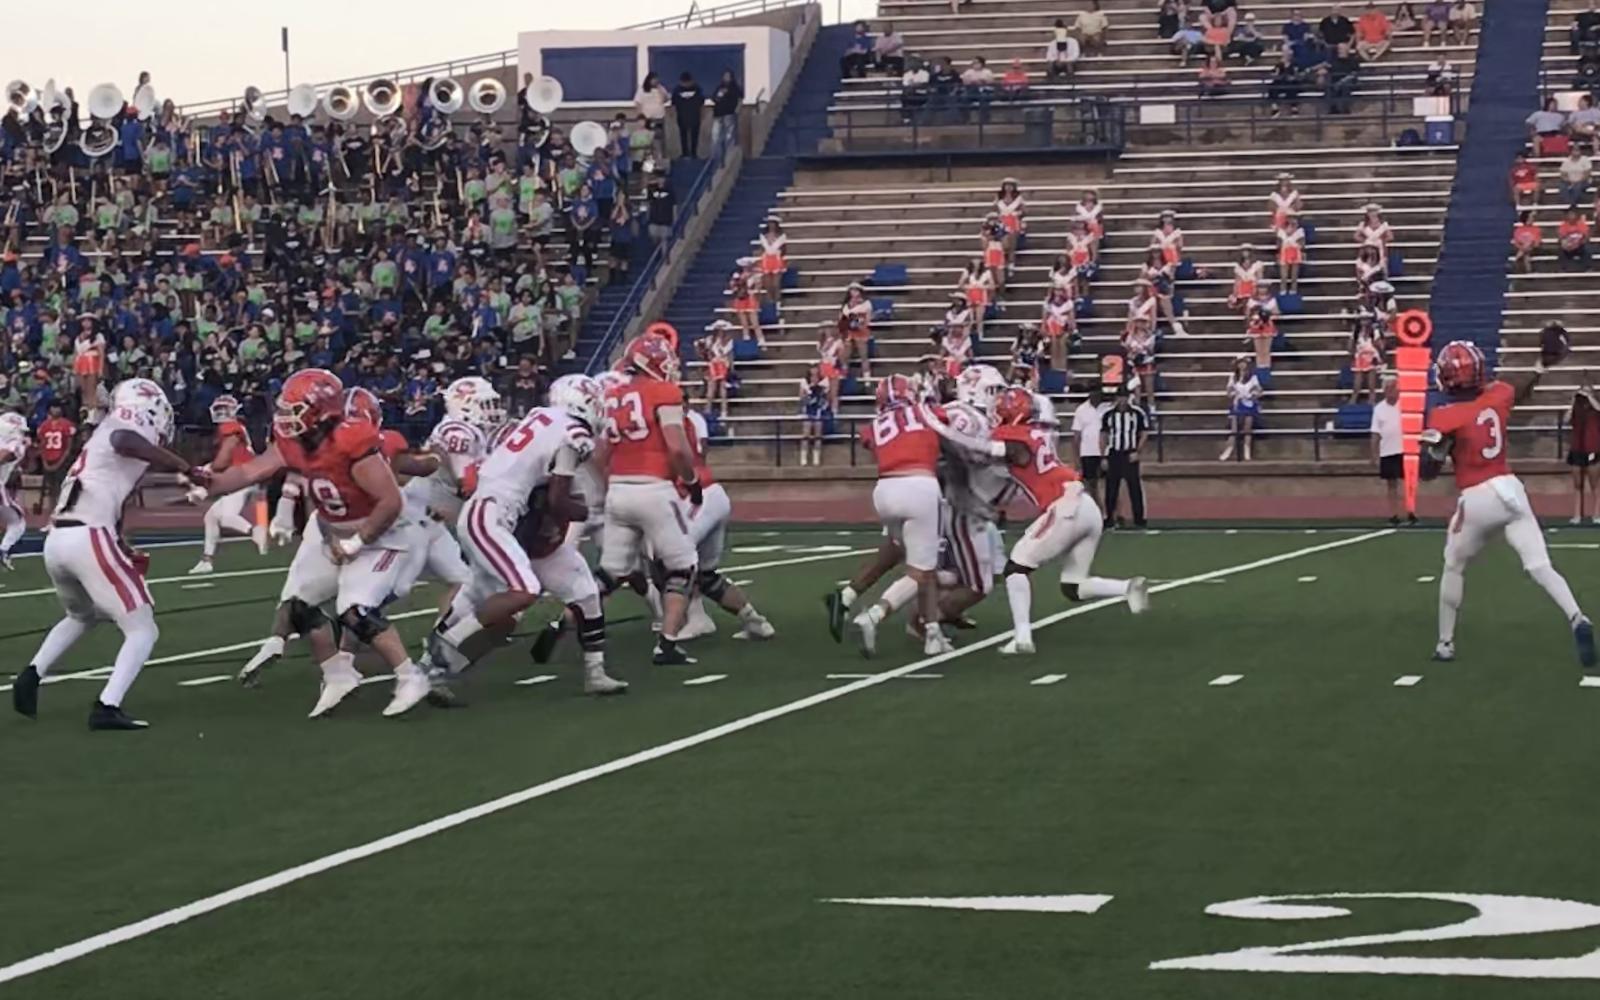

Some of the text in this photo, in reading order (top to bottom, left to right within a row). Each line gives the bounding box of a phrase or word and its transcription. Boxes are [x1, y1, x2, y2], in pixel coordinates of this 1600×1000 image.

[1102, 354, 1123, 383] 2
[1475, 407, 1503, 459] 3
[1149, 892, 1600, 979] 2
